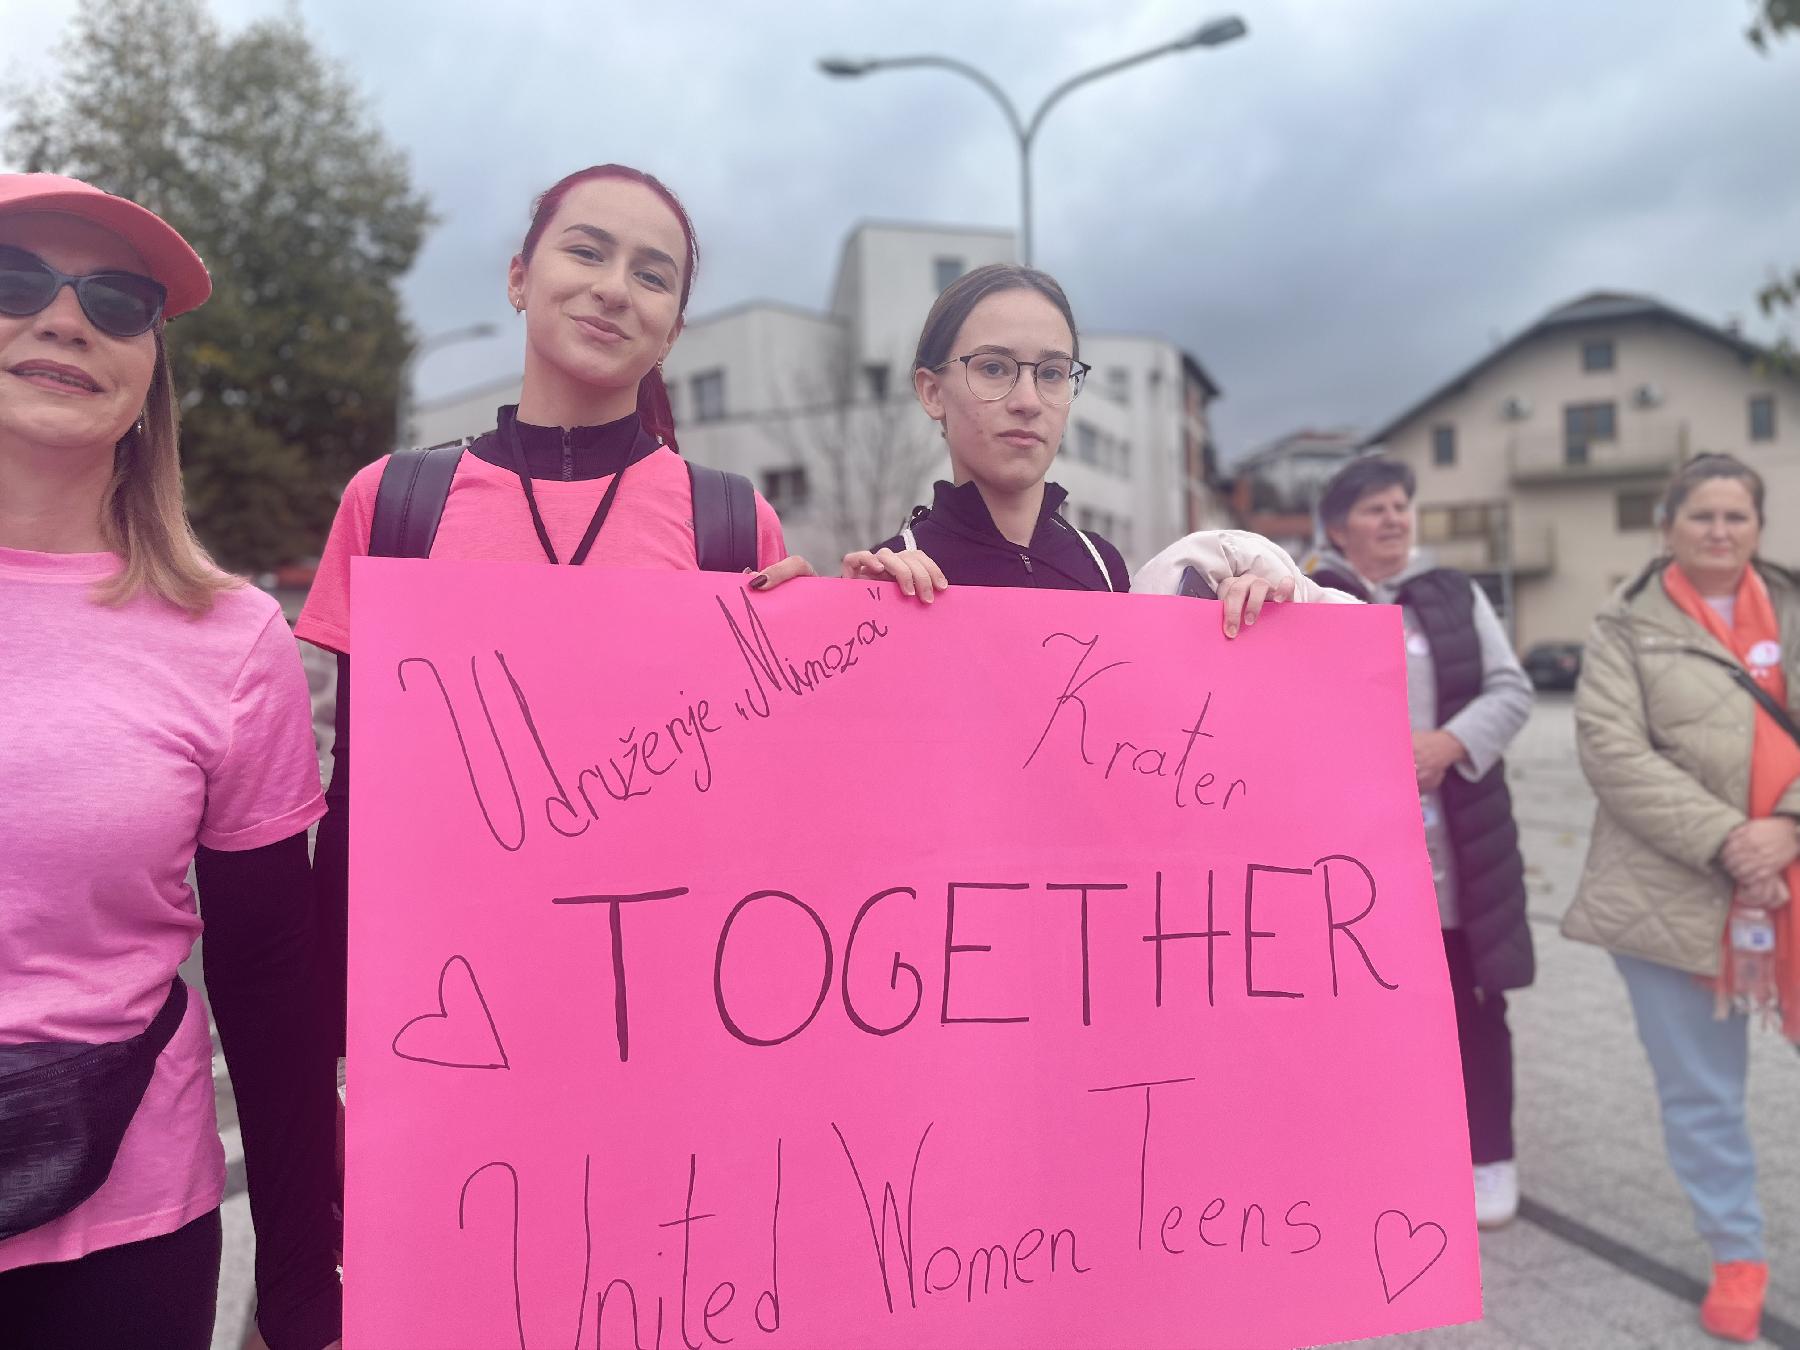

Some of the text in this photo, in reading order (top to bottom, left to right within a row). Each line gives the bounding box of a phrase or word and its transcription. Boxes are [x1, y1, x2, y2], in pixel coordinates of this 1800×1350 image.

[397, 650, 722, 852] Udruženje
[1022, 632, 1246, 810] Krater
[552, 854, 1400, 1063] TOGETHER
[459, 1077, 1321, 1350] United Women Teens
